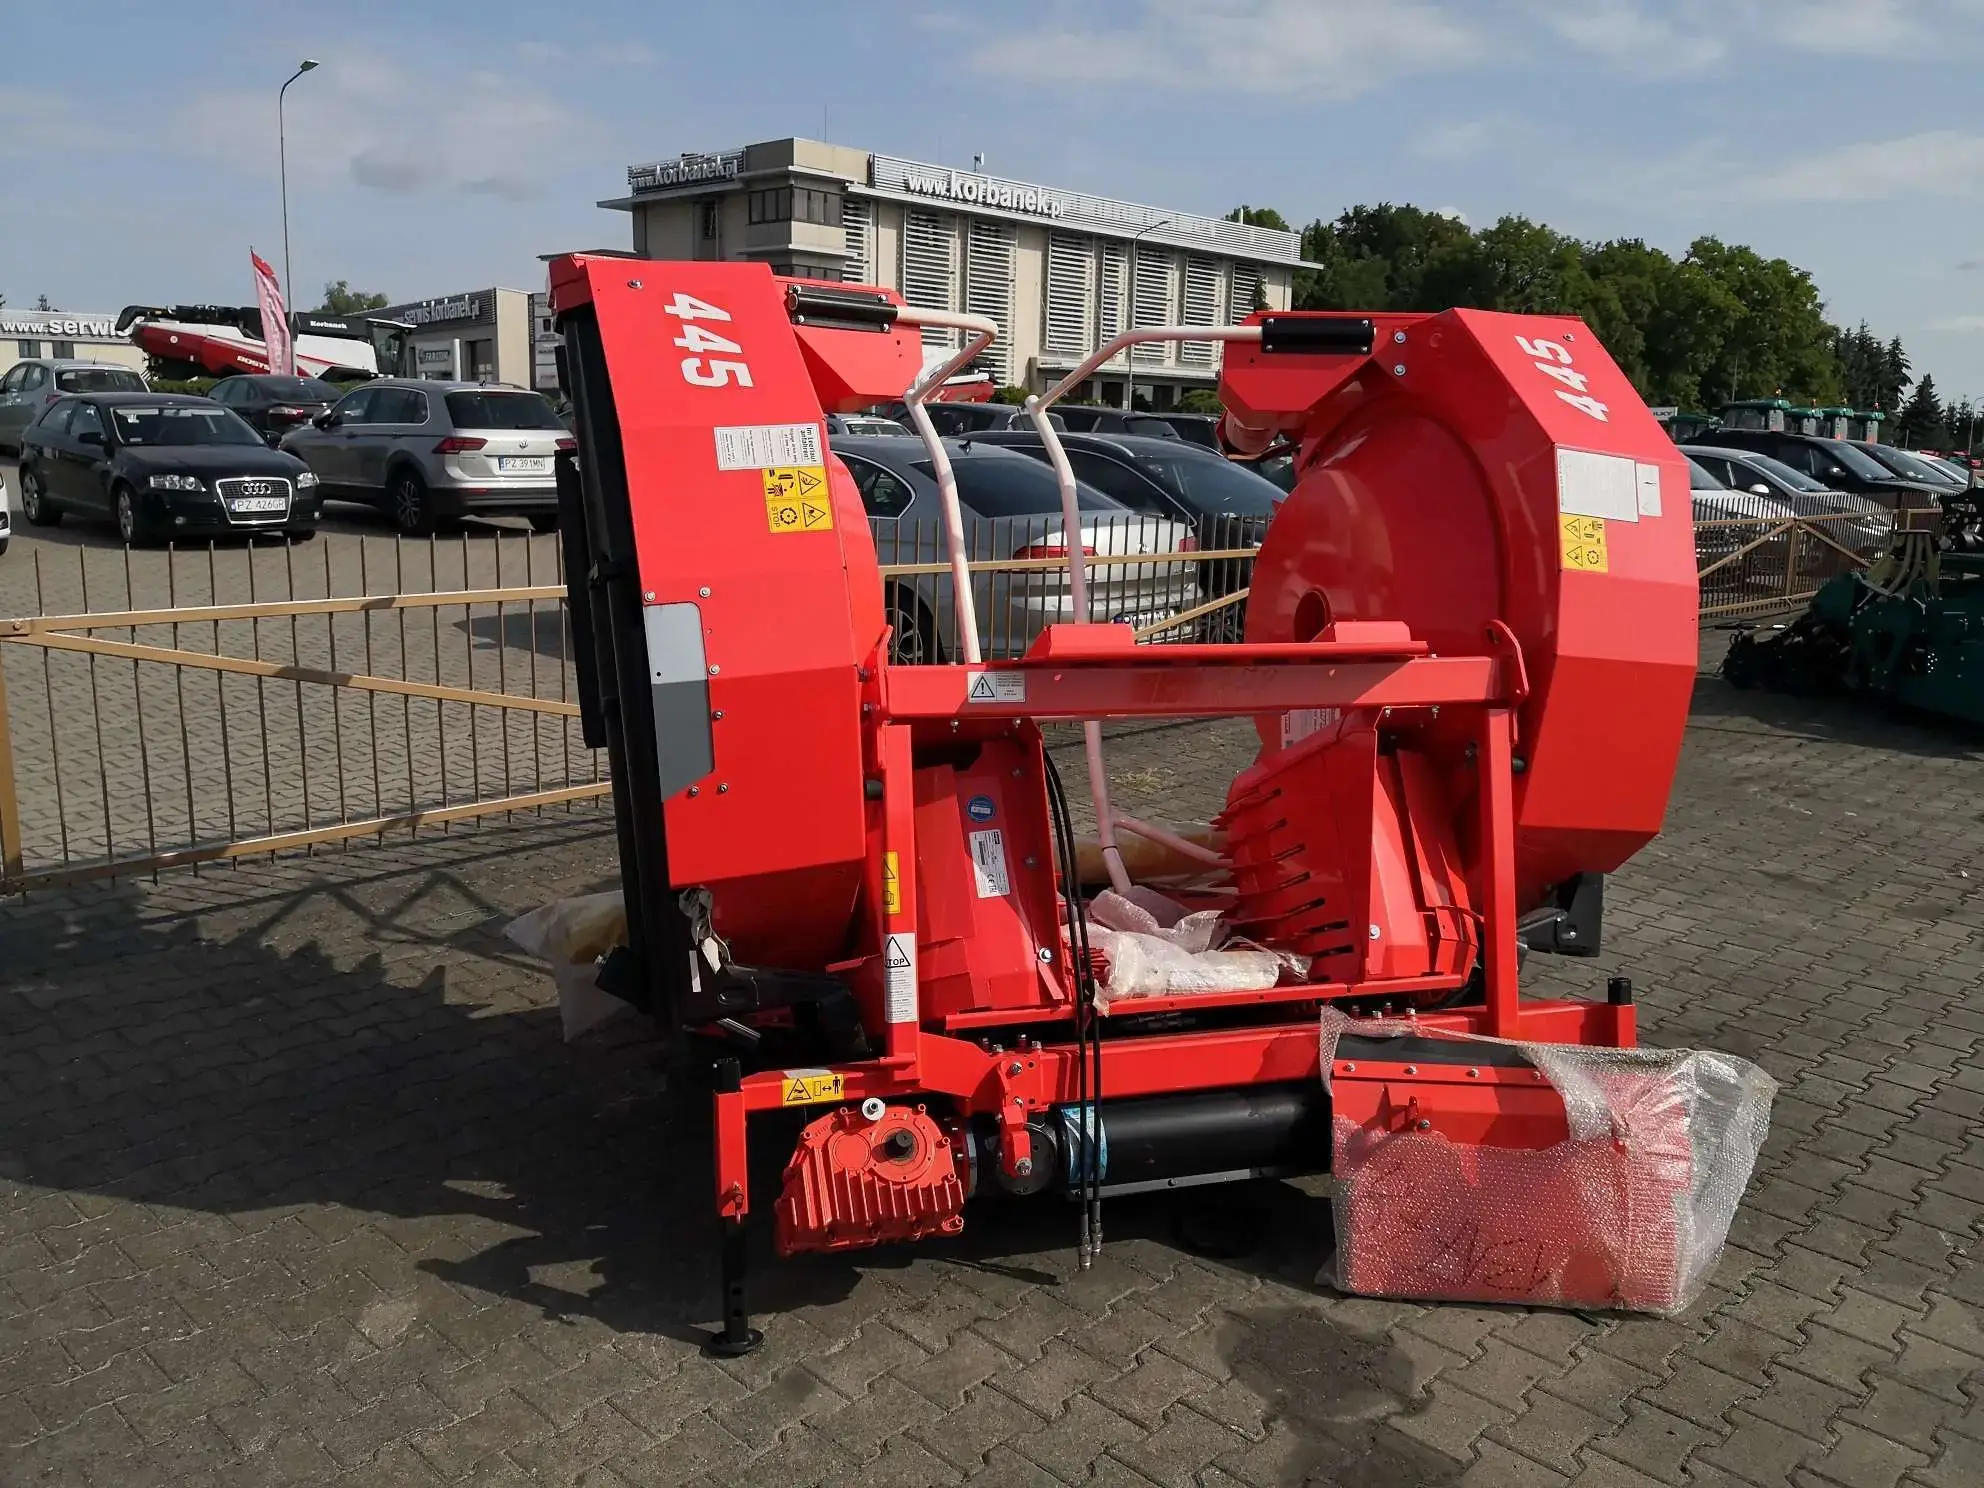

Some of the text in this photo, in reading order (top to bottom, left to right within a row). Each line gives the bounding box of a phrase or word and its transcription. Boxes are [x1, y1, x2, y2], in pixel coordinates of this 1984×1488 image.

[908, 170, 1064, 218] www.korbanek.pl
[663, 292, 754, 388] 445
[1514, 335, 1609, 423] 445
[237, 500, 252, 510] PZ
[771, 507, 781, 528] STOP
